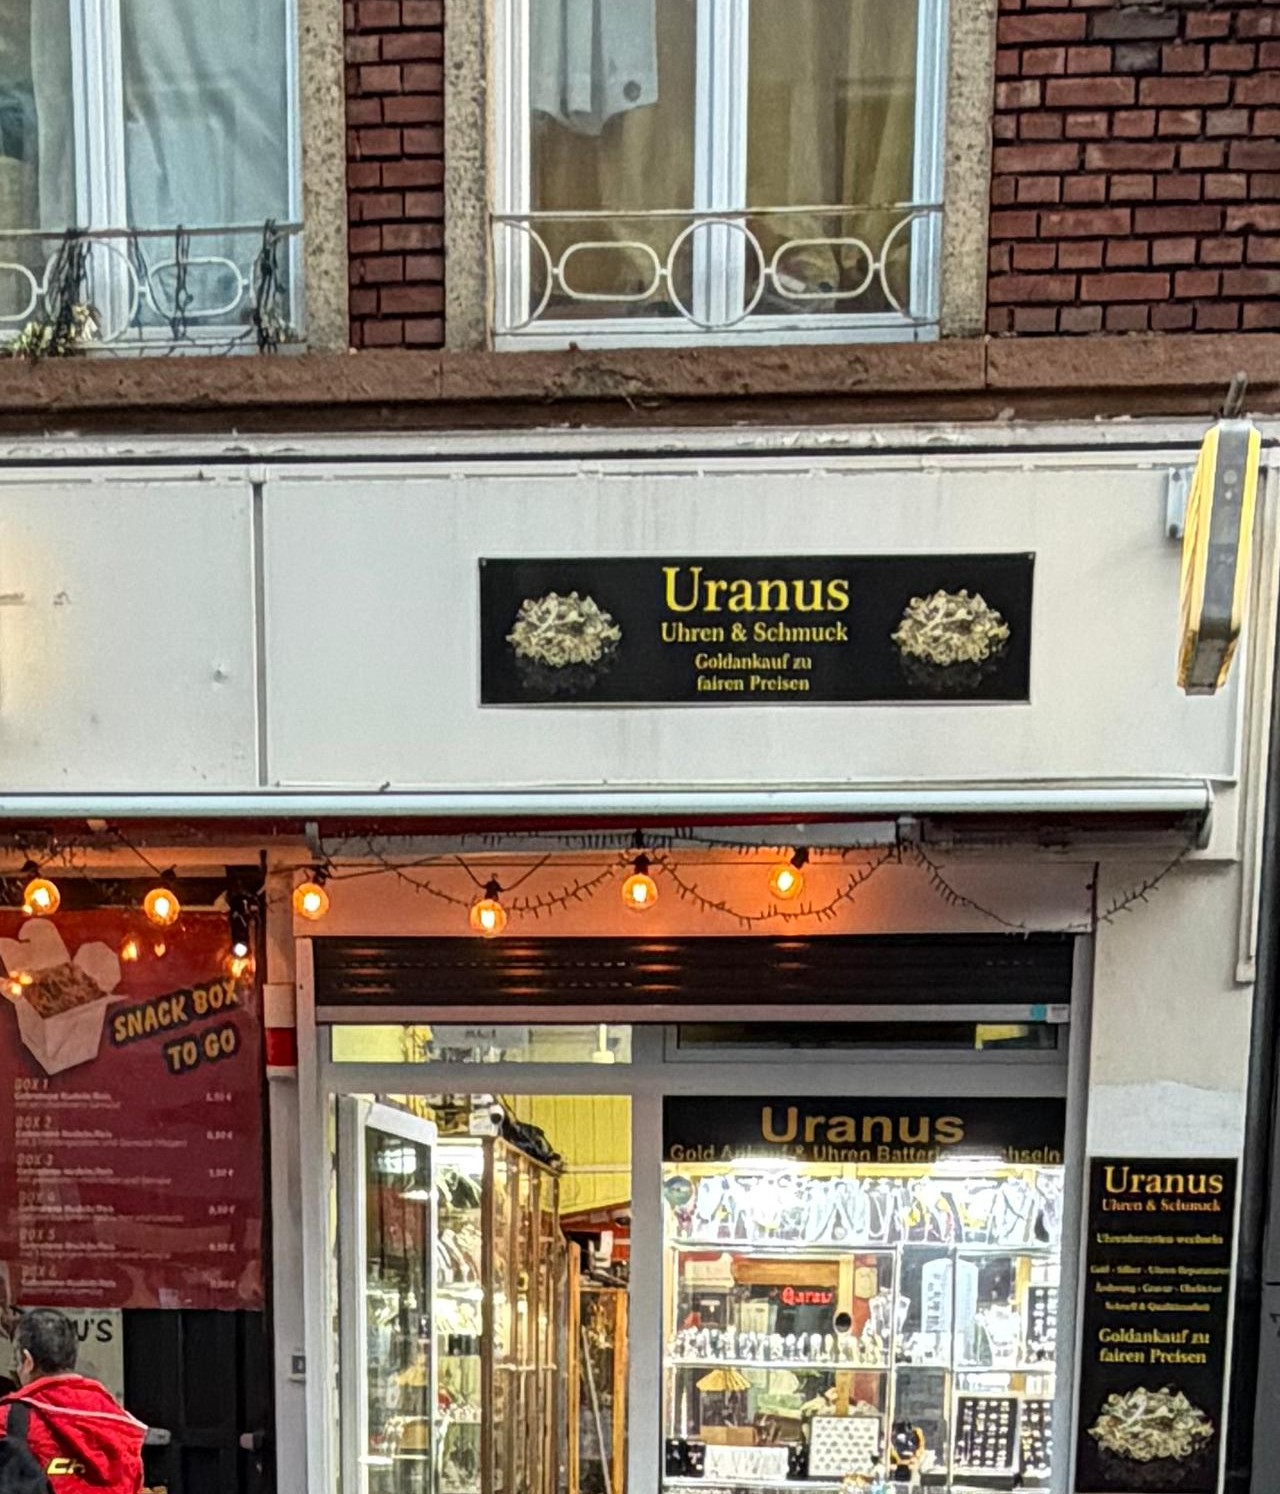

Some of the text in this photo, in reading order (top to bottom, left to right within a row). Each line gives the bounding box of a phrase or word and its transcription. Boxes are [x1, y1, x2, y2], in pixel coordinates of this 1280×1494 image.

[661, 566, 850, 613] Uranus
[661, 621, 849, 644] Uhren & Schmuck
[695, 653, 812, 672] Goldankauf zu
[697, 676, 810, 692] fairen Preisen
[113, 980, 240, 1043] SNACK BOX
[167, 1027, 236, 1071] TO GO
[762, 1106, 966, 1144] Uranus
[670, 1144, 714, 1161] Gold
[813, 1144, 870, 1161] Uhren
[1104, 1166, 1224, 1194] Uranus
[1102, 1199, 1221, 1212] Uhren & Schmuck
[1098, 1328, 1210, 1344] Goldankauf zu
[1099, 1348, 1207, 1364] fairen Preisen
